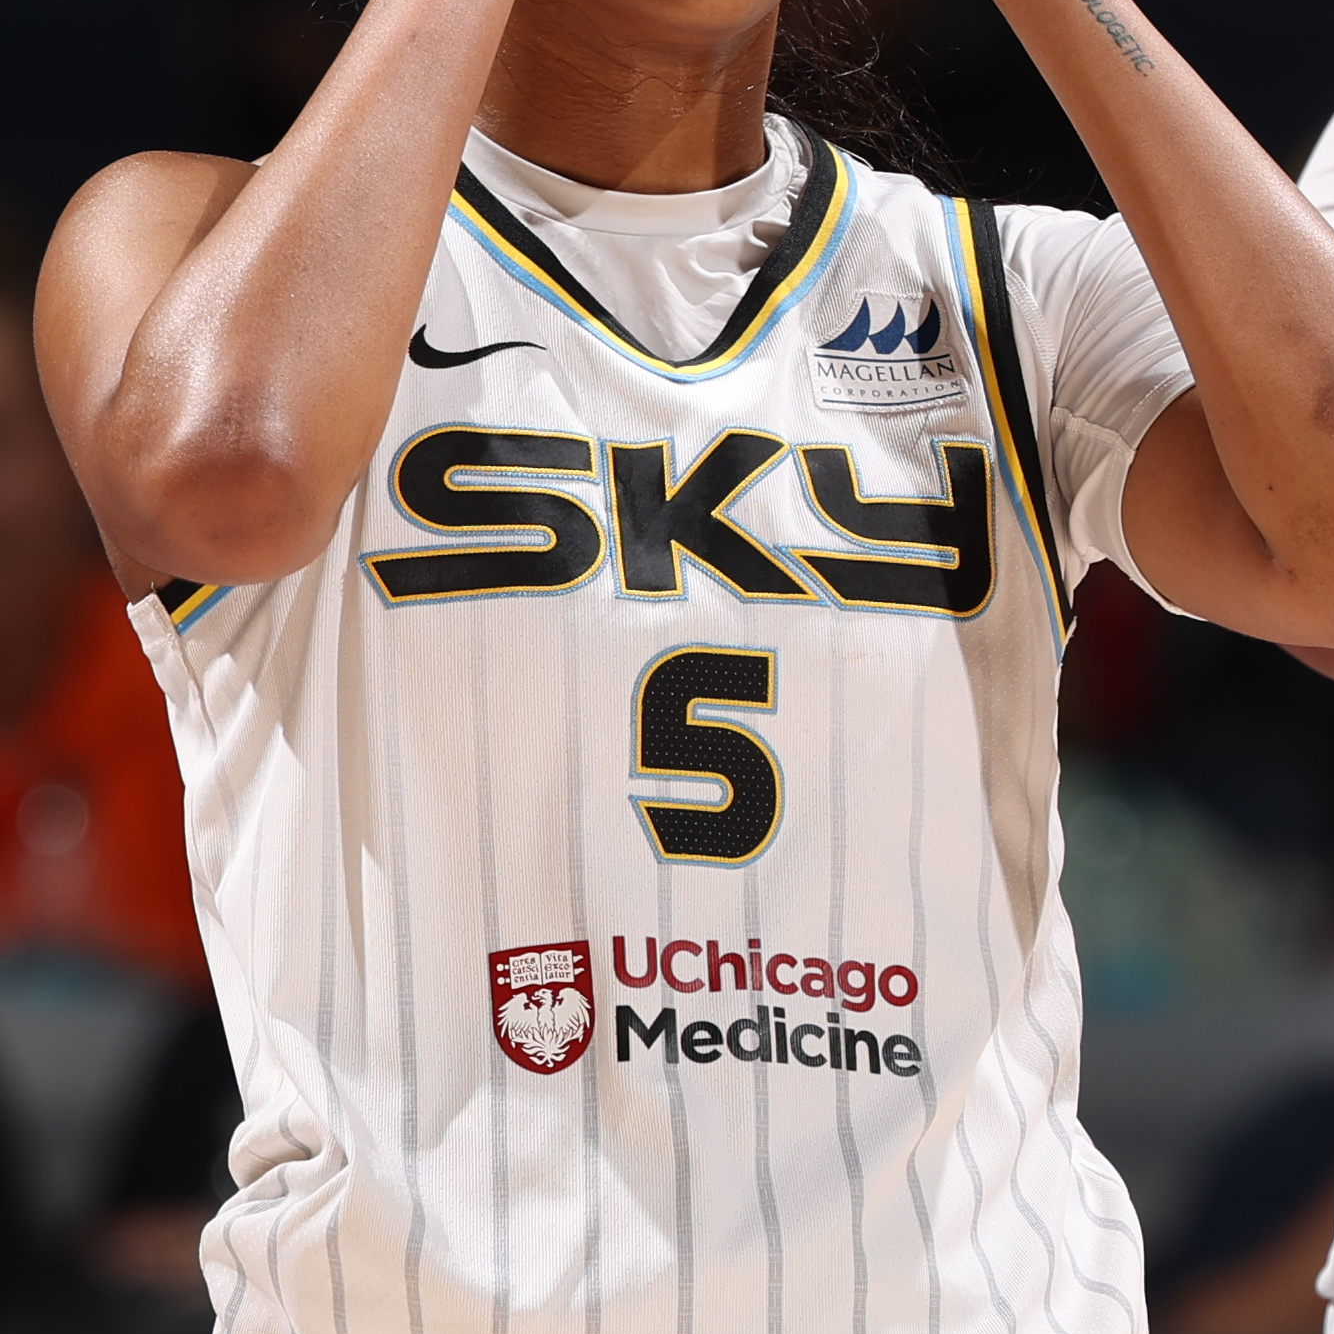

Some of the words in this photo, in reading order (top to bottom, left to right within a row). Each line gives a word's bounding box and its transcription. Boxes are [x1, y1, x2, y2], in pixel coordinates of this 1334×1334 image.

[817, 359, 956, 382] MAGELLAN
[820, 380, 961, 398] CORPORATION
[358, 421, 998, 622] SKY
[629, 642, 786, 869] 5
[612, 935, 919, 1013] UChicago
[615, 1004, 923, 1078] Medicine
